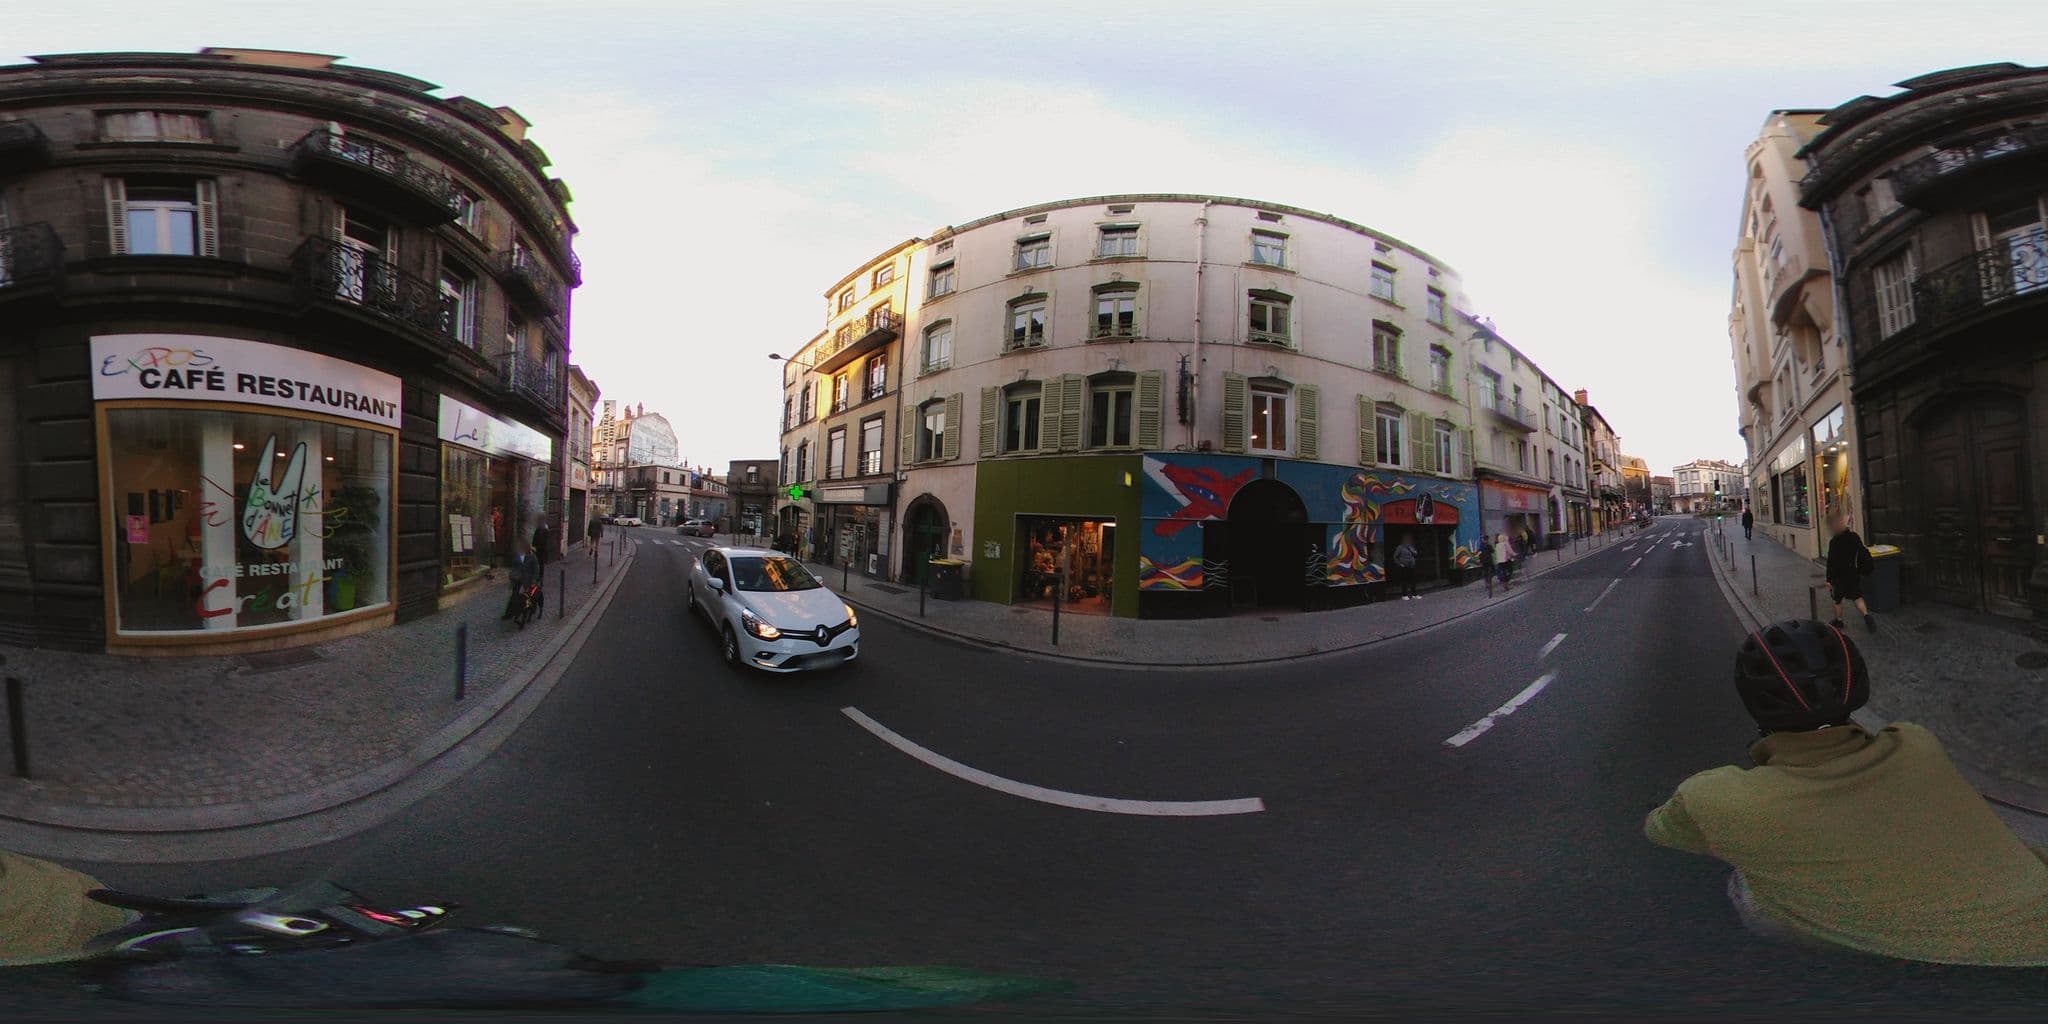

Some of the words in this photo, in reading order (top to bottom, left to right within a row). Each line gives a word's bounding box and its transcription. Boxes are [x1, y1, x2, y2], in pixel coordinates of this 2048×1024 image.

[100, 347, 213, 376] EXPOS
[139, 365, 225, 391] CAFÉ
[237, 373, 397, 418] RESTAURANT
[602, 402, 610, 461] RESTAURANT
[250, 558, 344, 576] RESTAURANT
